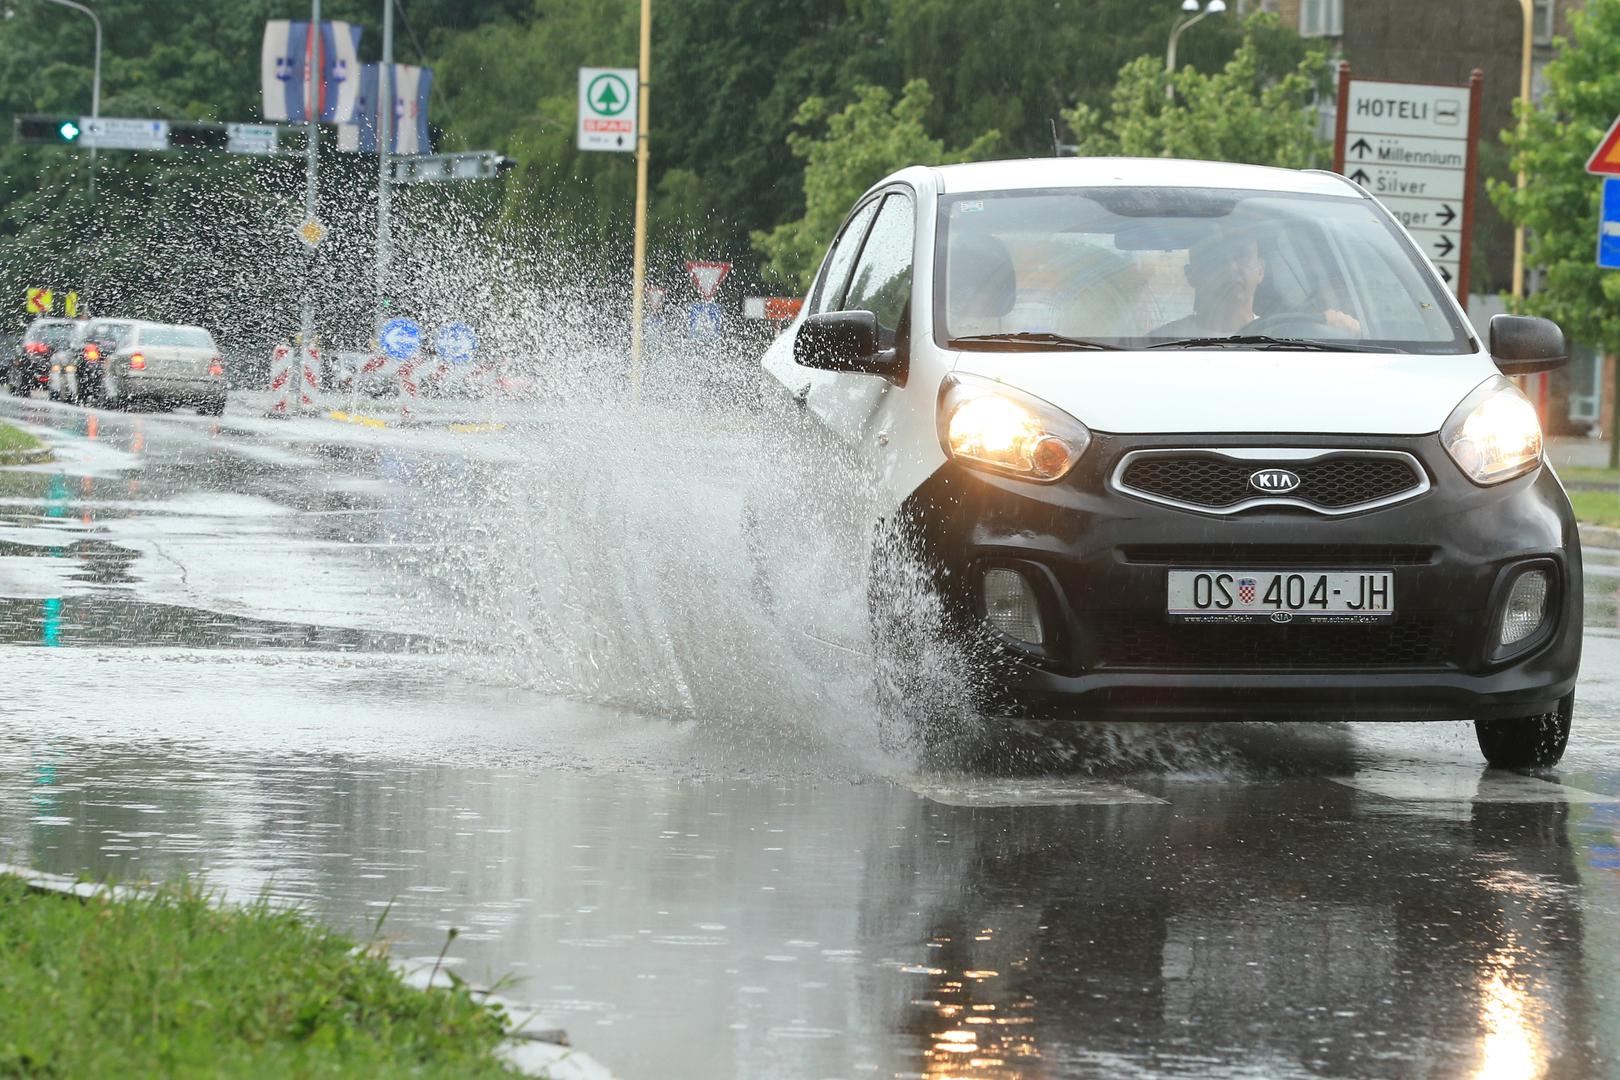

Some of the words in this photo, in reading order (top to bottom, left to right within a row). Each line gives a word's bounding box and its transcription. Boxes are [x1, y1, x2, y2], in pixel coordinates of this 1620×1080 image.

[1356, 97, 1428, 120] HOTELI
[584, 119, 632, 133] SPAR
[1378, 146, 1462, 166] Millennium
[1377, 176, 1428, 195] Silver
[1392, 210, 1429, 228] nger
[1258, 473, 1293, 488] KIA
[1193, 573, 1234, 610] OS
[1262, 573, 1388, 610] 404-JH
